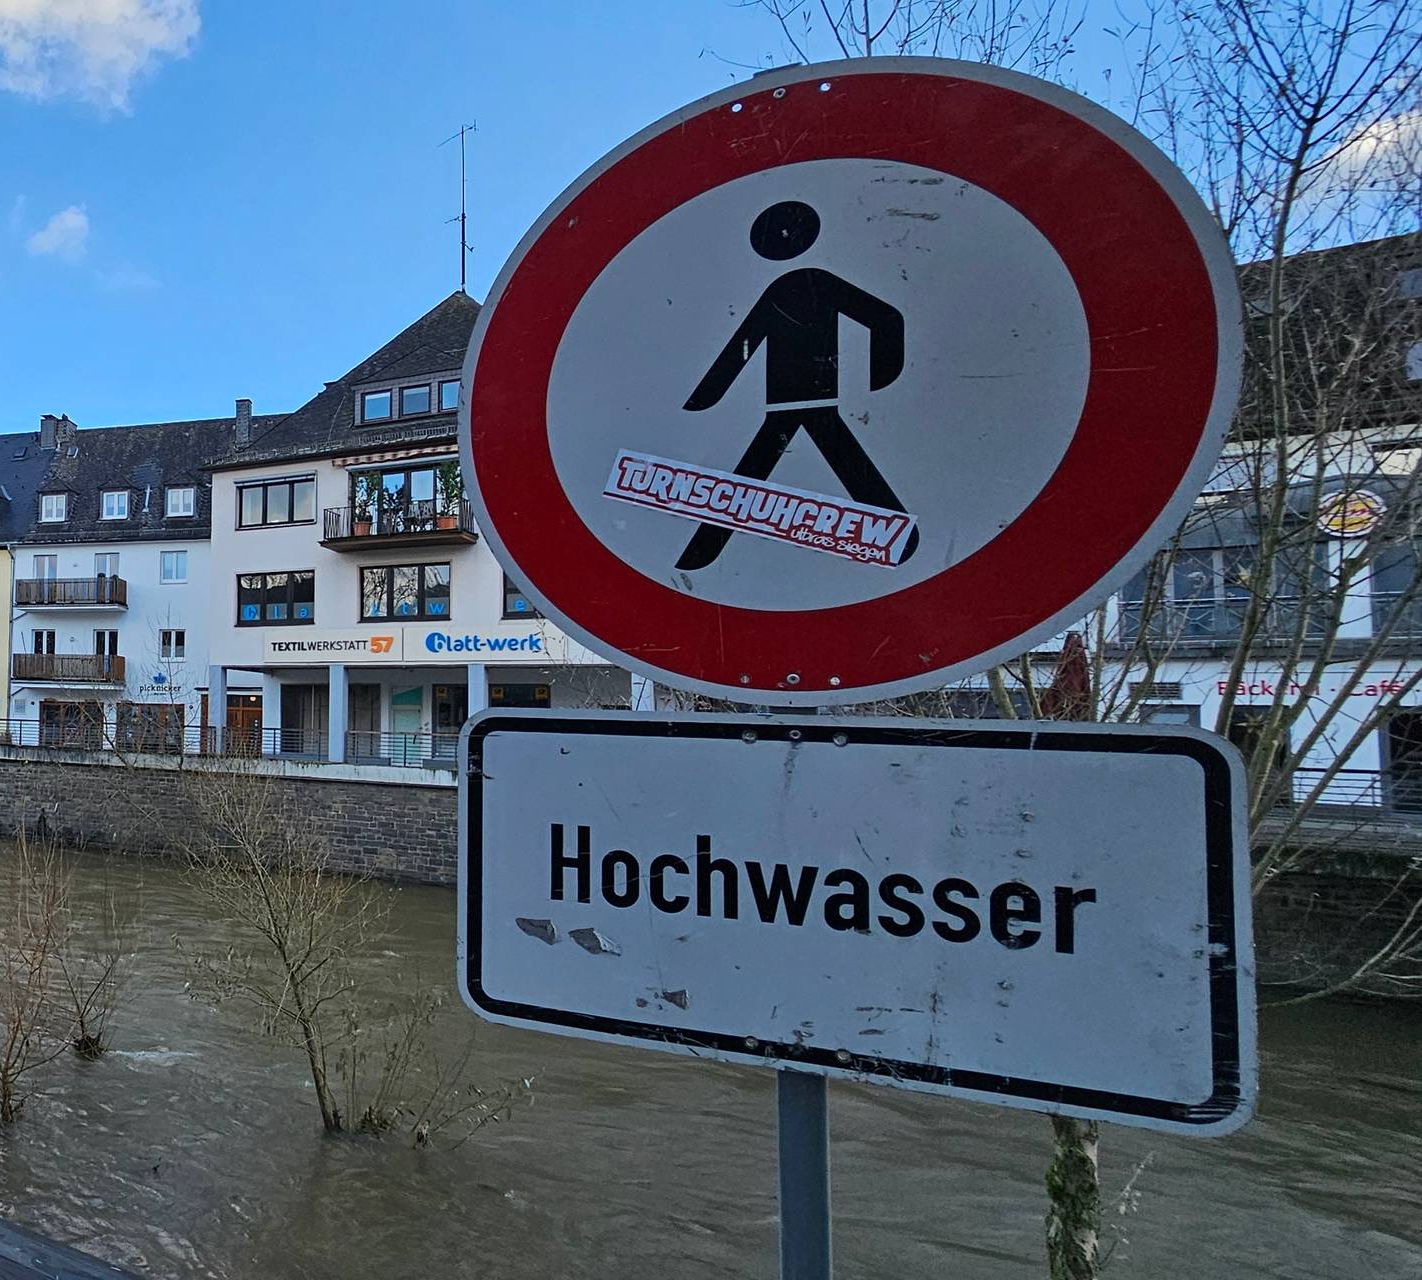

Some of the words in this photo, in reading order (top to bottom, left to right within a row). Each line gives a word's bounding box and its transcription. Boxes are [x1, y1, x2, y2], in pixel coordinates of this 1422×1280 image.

[621, 460, 906, 548] TURNSCHUHCREW
[837, 540, 886, 561] siegen
[271, 639, 369, 652] TEXTILWERKSTATT
[370, 636, 394, 653] 57
[550, 822, 1097, 955] Hochwasser
